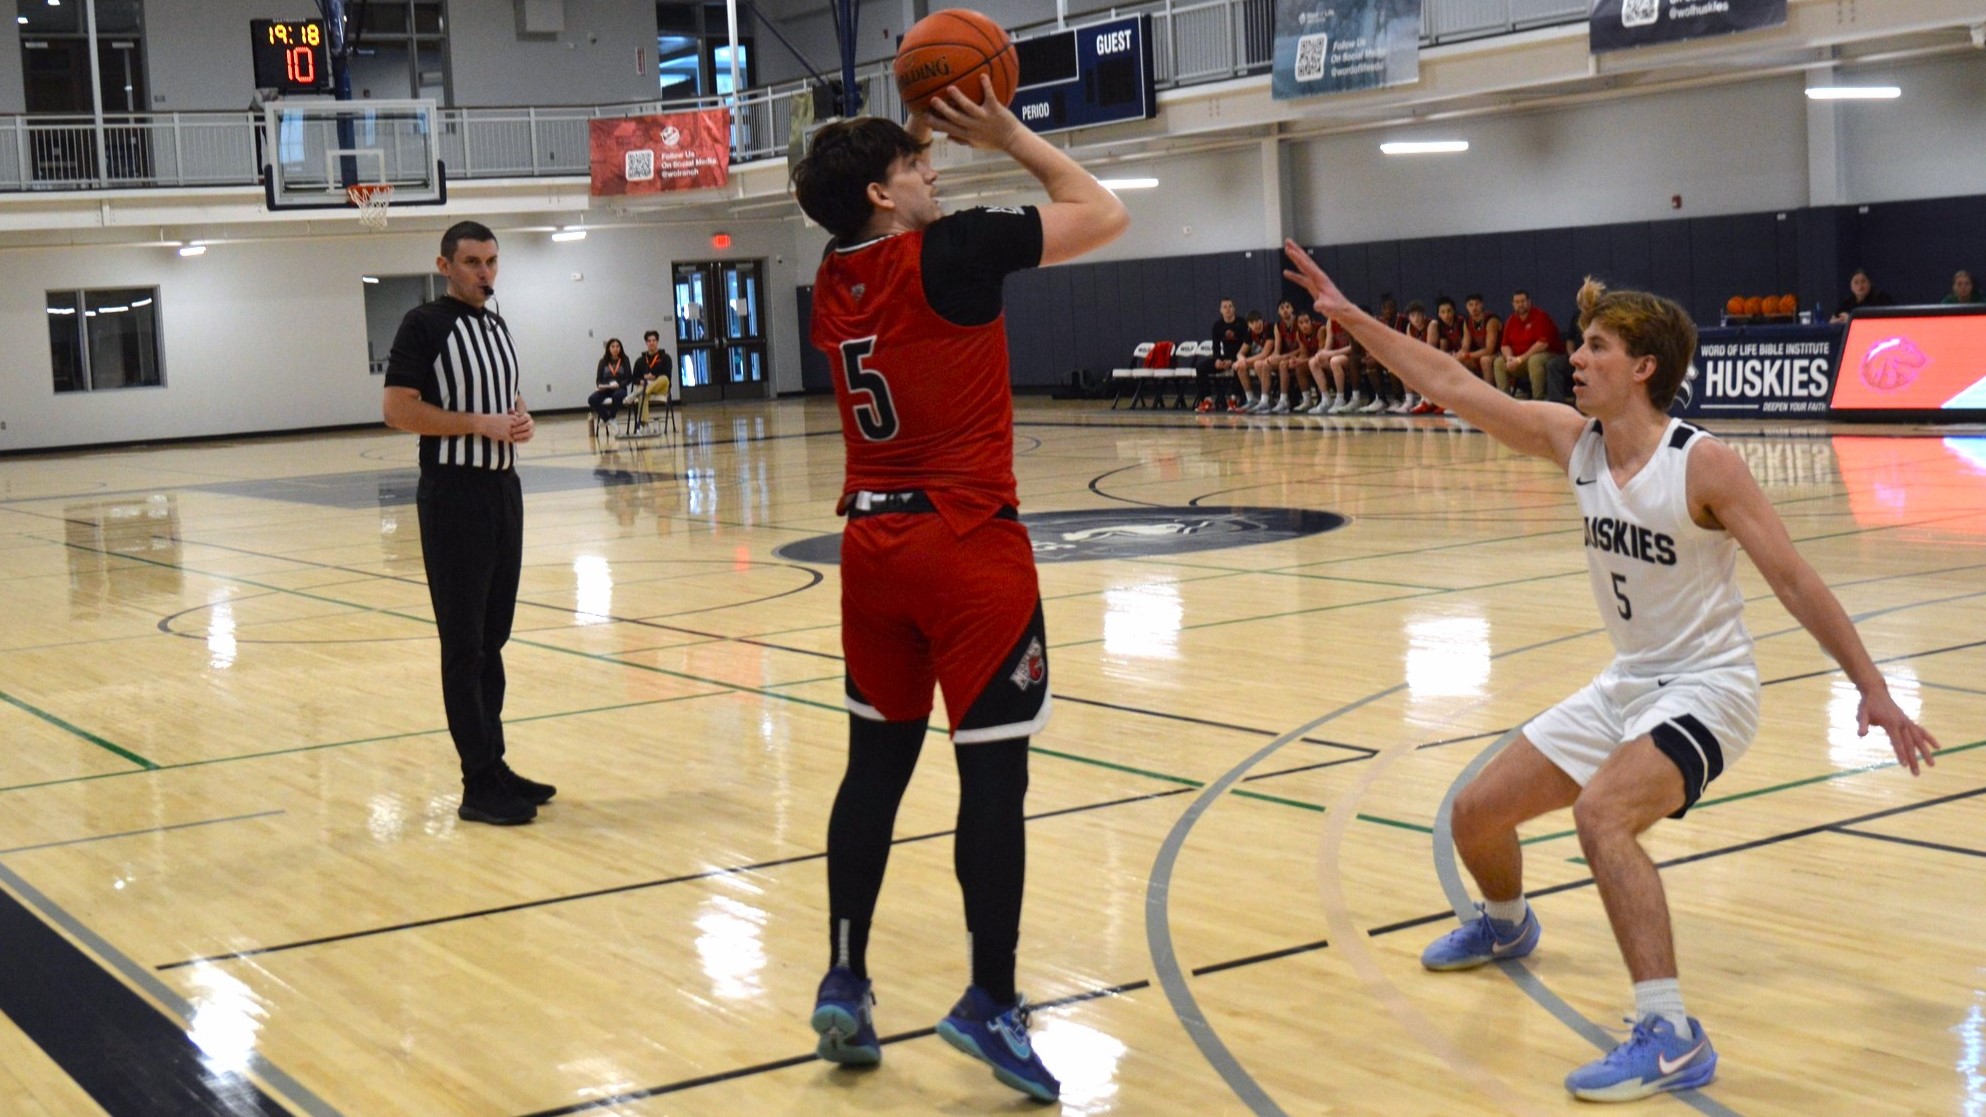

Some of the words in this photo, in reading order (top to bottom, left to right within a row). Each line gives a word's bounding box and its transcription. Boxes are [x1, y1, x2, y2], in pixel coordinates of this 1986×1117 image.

[269, 24, 320, 46] 19:18
[1096, 29, 1132, 55] GUEST
[1333, 40, 1356, 50] Follow
[286, 46, 314, 82] 10
[1331, 54, 1341, 64] On
[1342, 50, 1364, 61] Social
[1021, 102, 1050, 120] PERIOD
[661, 152, 684, 160] Follow
[684, 150, 695, 158] Us
[661, 161, 672, 169] On
[673, 159, 694, 168] Social
[695, 157, 717, 166] Media
[1701, 344, 1725, 357] WORD
[1727, 344, 1739, 356] OF
[1740, 343, 1758, 356] LIFE
[1759, 343, 1784, 355] BIBLE
[1785, 342, 1830, 355] INSTITUTE
[1705, 357, 1829, 397] HUSKIES
[839, 335, 900, 441] 5
[1763, 402, 1788, 412] DEEPEN
[1790, 402, 1807, 412] YOUR
[1808, 402, 1827, 412] FAITH
[1610, 571, 1632, 621] 5
